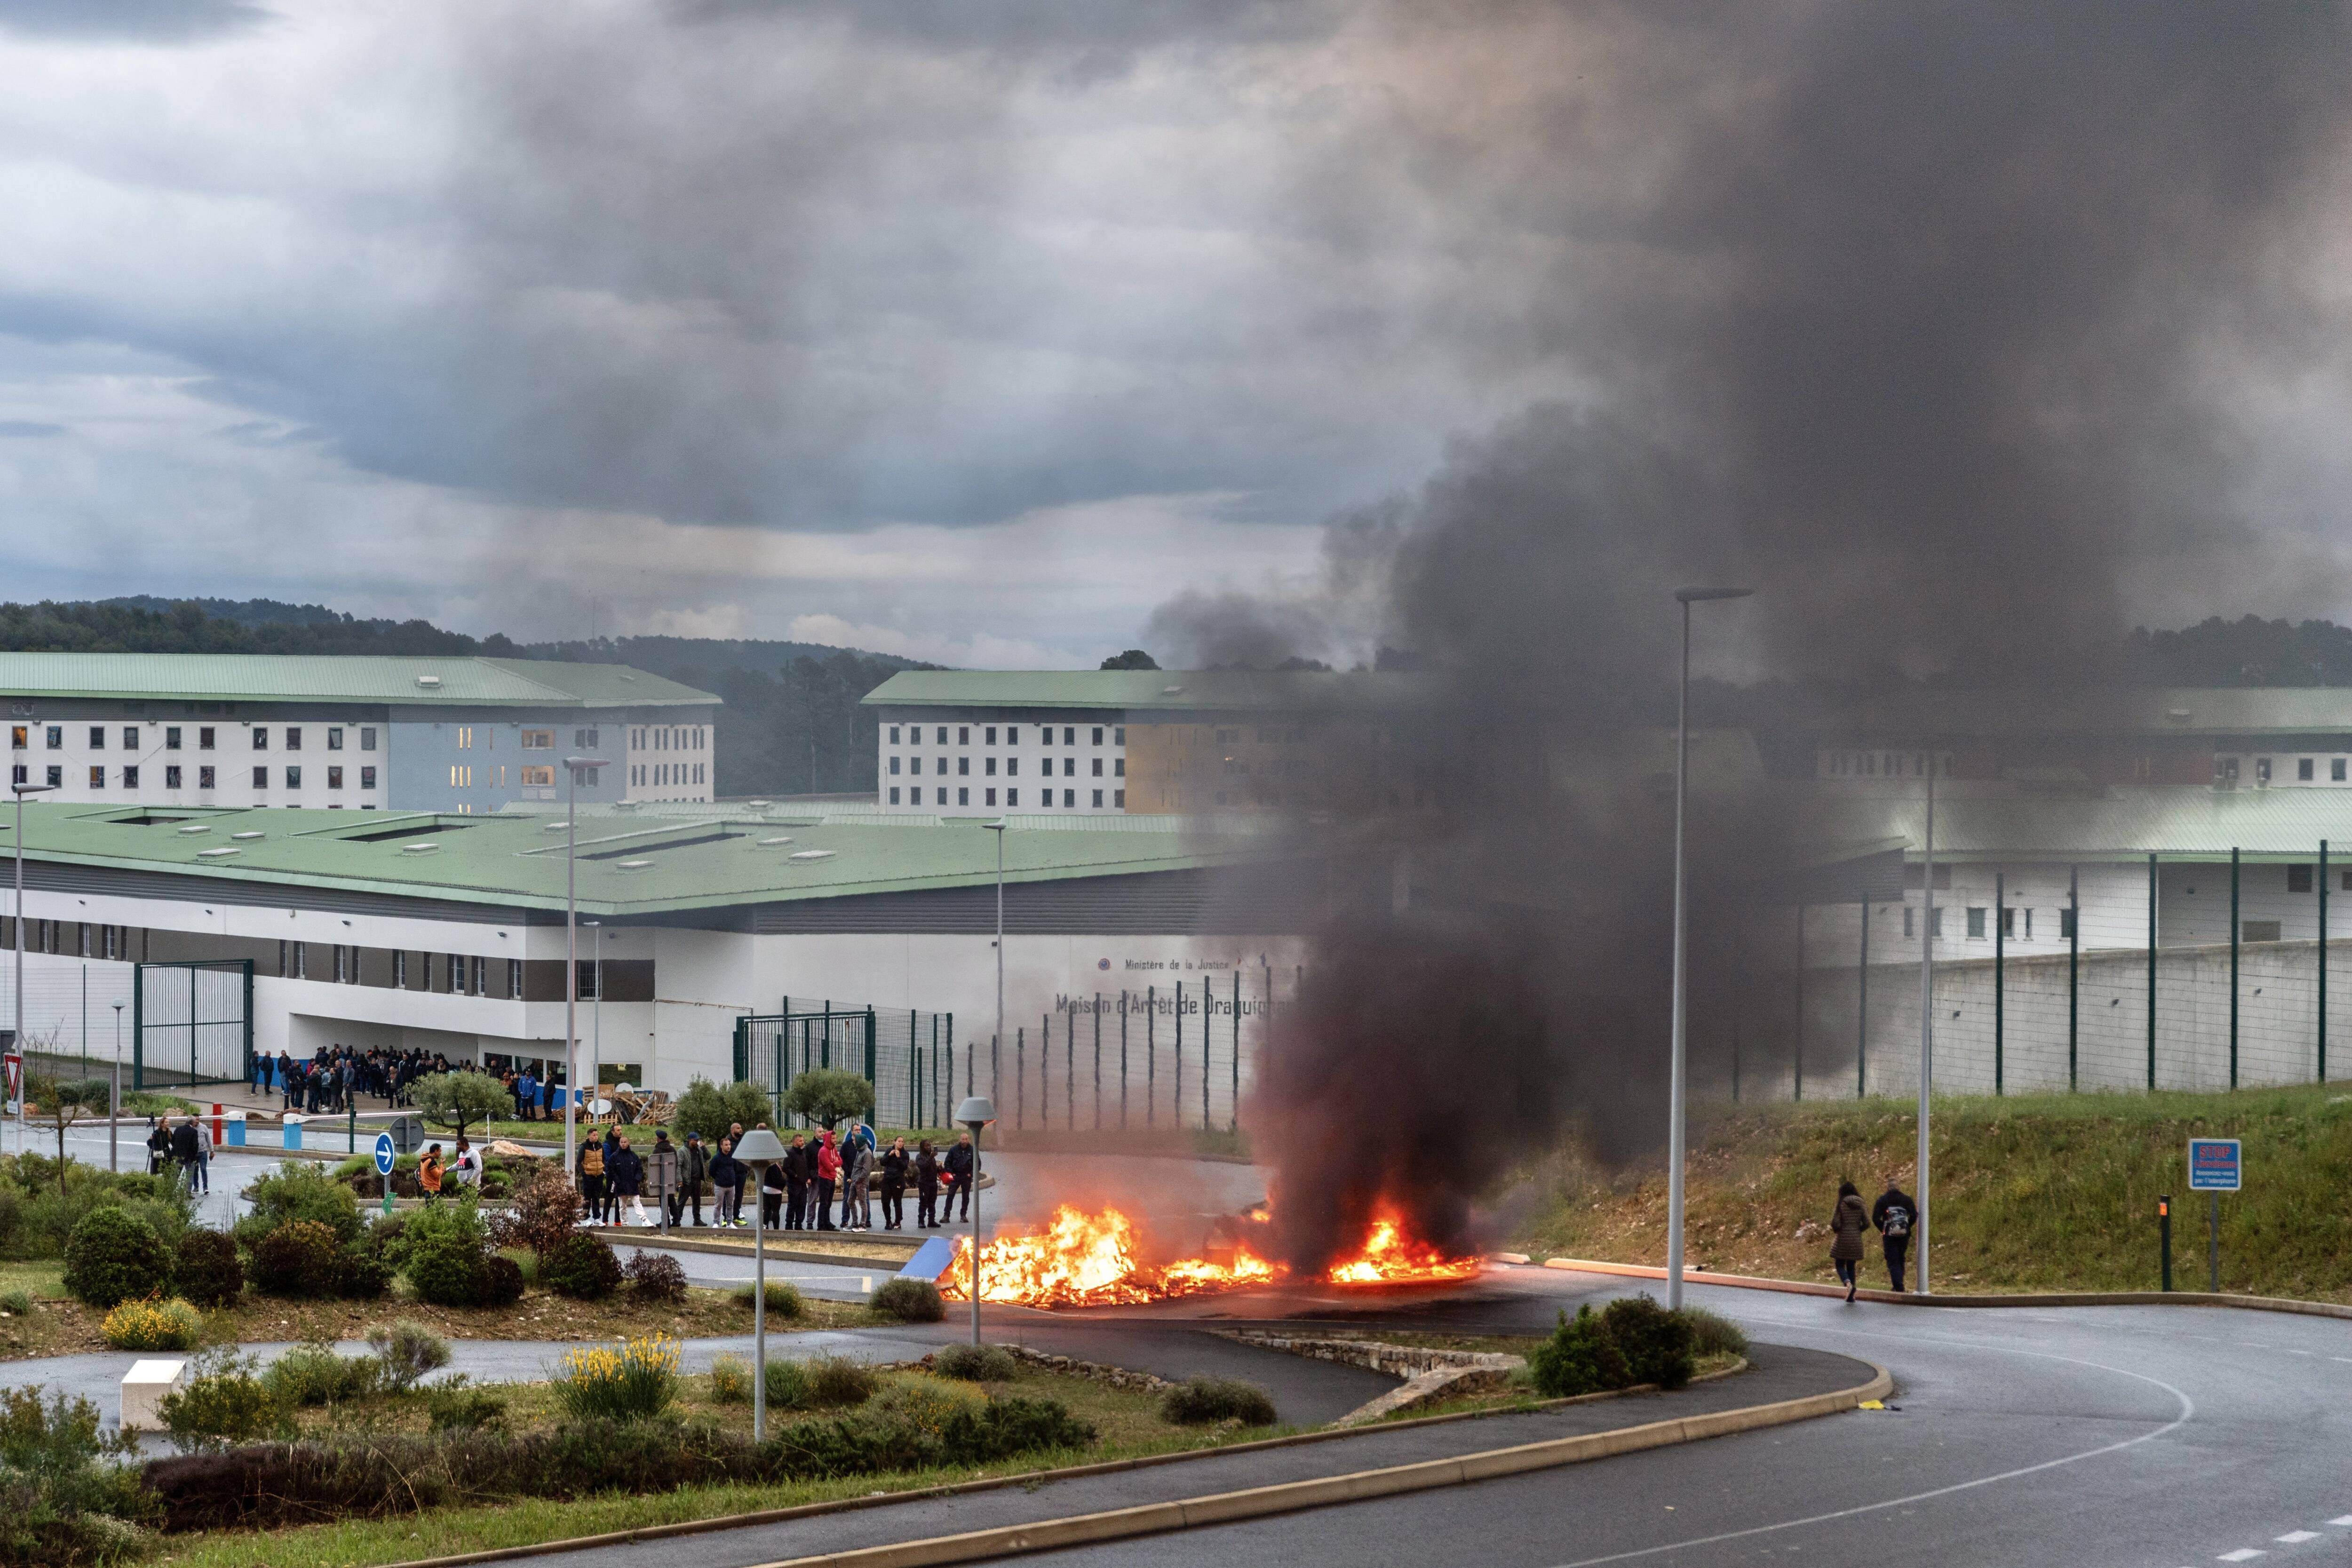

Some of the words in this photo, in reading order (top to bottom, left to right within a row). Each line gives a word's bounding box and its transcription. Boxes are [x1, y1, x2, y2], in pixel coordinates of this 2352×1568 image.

[1125, 959, 1164, 970] Ministère
[1169, 959, 1180, 970] de
[1185, 959, 1193, 970] la
[1198, 958, 1230, 970] Justice
[1180, 993, 1198, 1014] de
[2199, 1146, 2232, 1159] STOP
